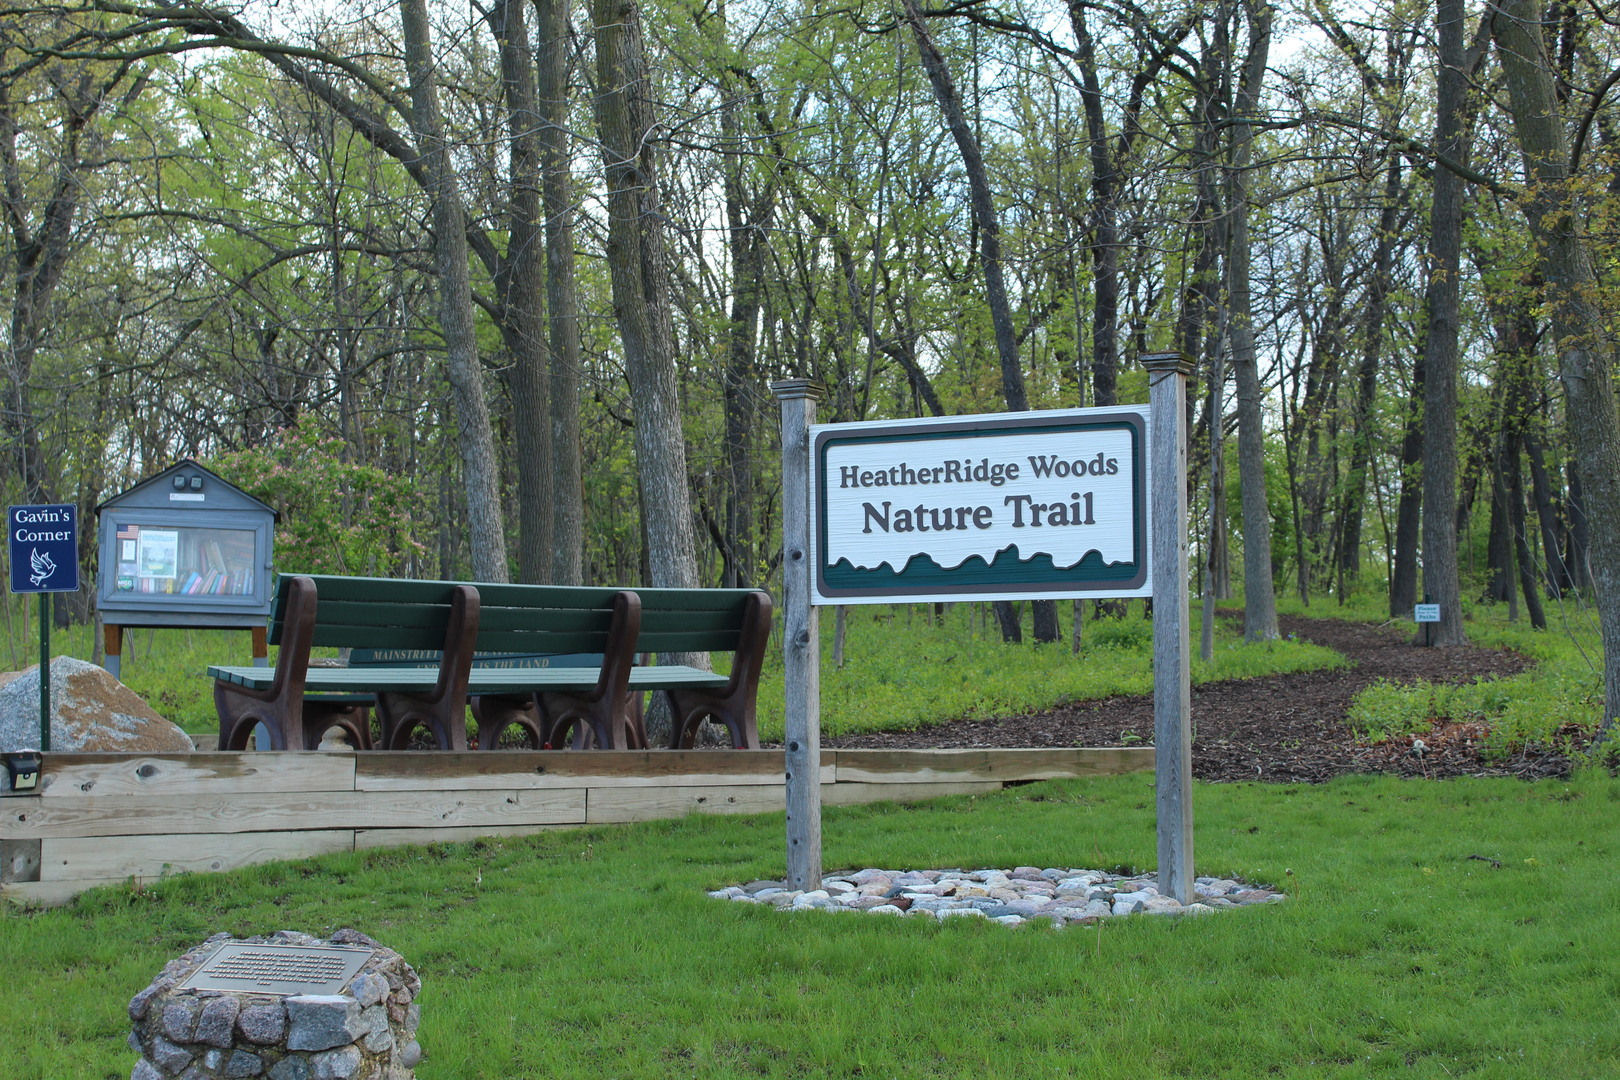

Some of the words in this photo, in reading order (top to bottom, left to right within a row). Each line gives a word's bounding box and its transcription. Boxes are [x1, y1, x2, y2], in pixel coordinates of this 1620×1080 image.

[840, 457, 1020, 487] HeatherRidge
[1027, 452, 1118, 478] Woods
[15, 508, 70, 524] Gavin's
[862, 501, 993, 534] Nature
[1004, 492, 1096, 528] Trail
[15, 528, 71, 542] Corner
[373, 650, 438, 660] MAINSTREET
